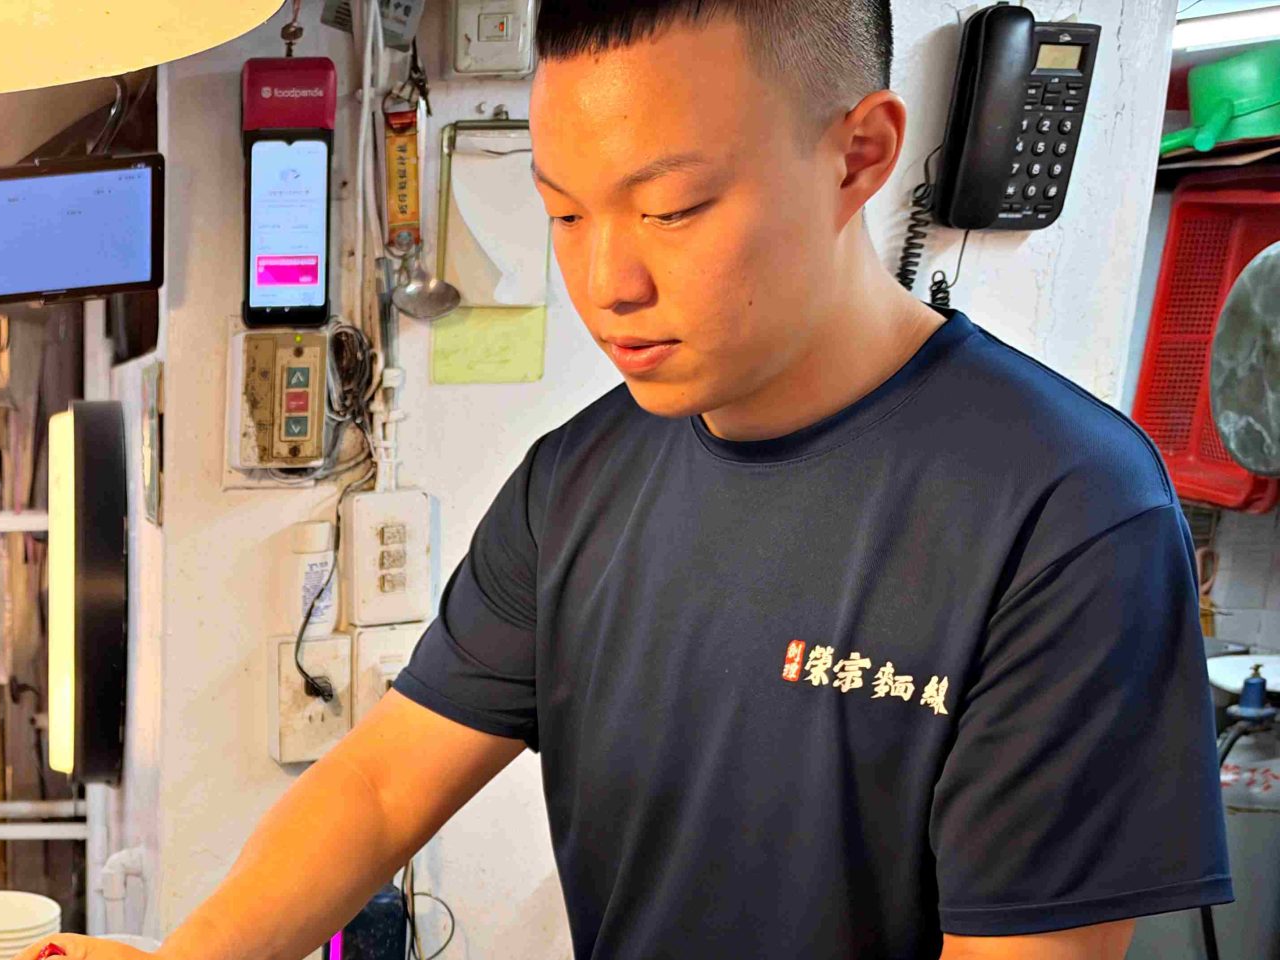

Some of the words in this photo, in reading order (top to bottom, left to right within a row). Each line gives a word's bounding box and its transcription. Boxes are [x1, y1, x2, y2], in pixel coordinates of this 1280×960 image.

[1021, 119, 1028, 131] 1
[1042, 120, 1051, 131] 2
[1063, 120, 1072, 132] 3
[1016, 141, 1024, 152] 4
[1036, 142, 1045, 153] 5
[1058, 142, 1067, 154] 6
[1011, 163, 1020, 175] 7
[1032, 163, 1040, 175] 8
[1053, 164, 1062, 175] 9
[1027, 185, 1036, 196] 0
[804, 644, 950, 715] 榮宗麵線
